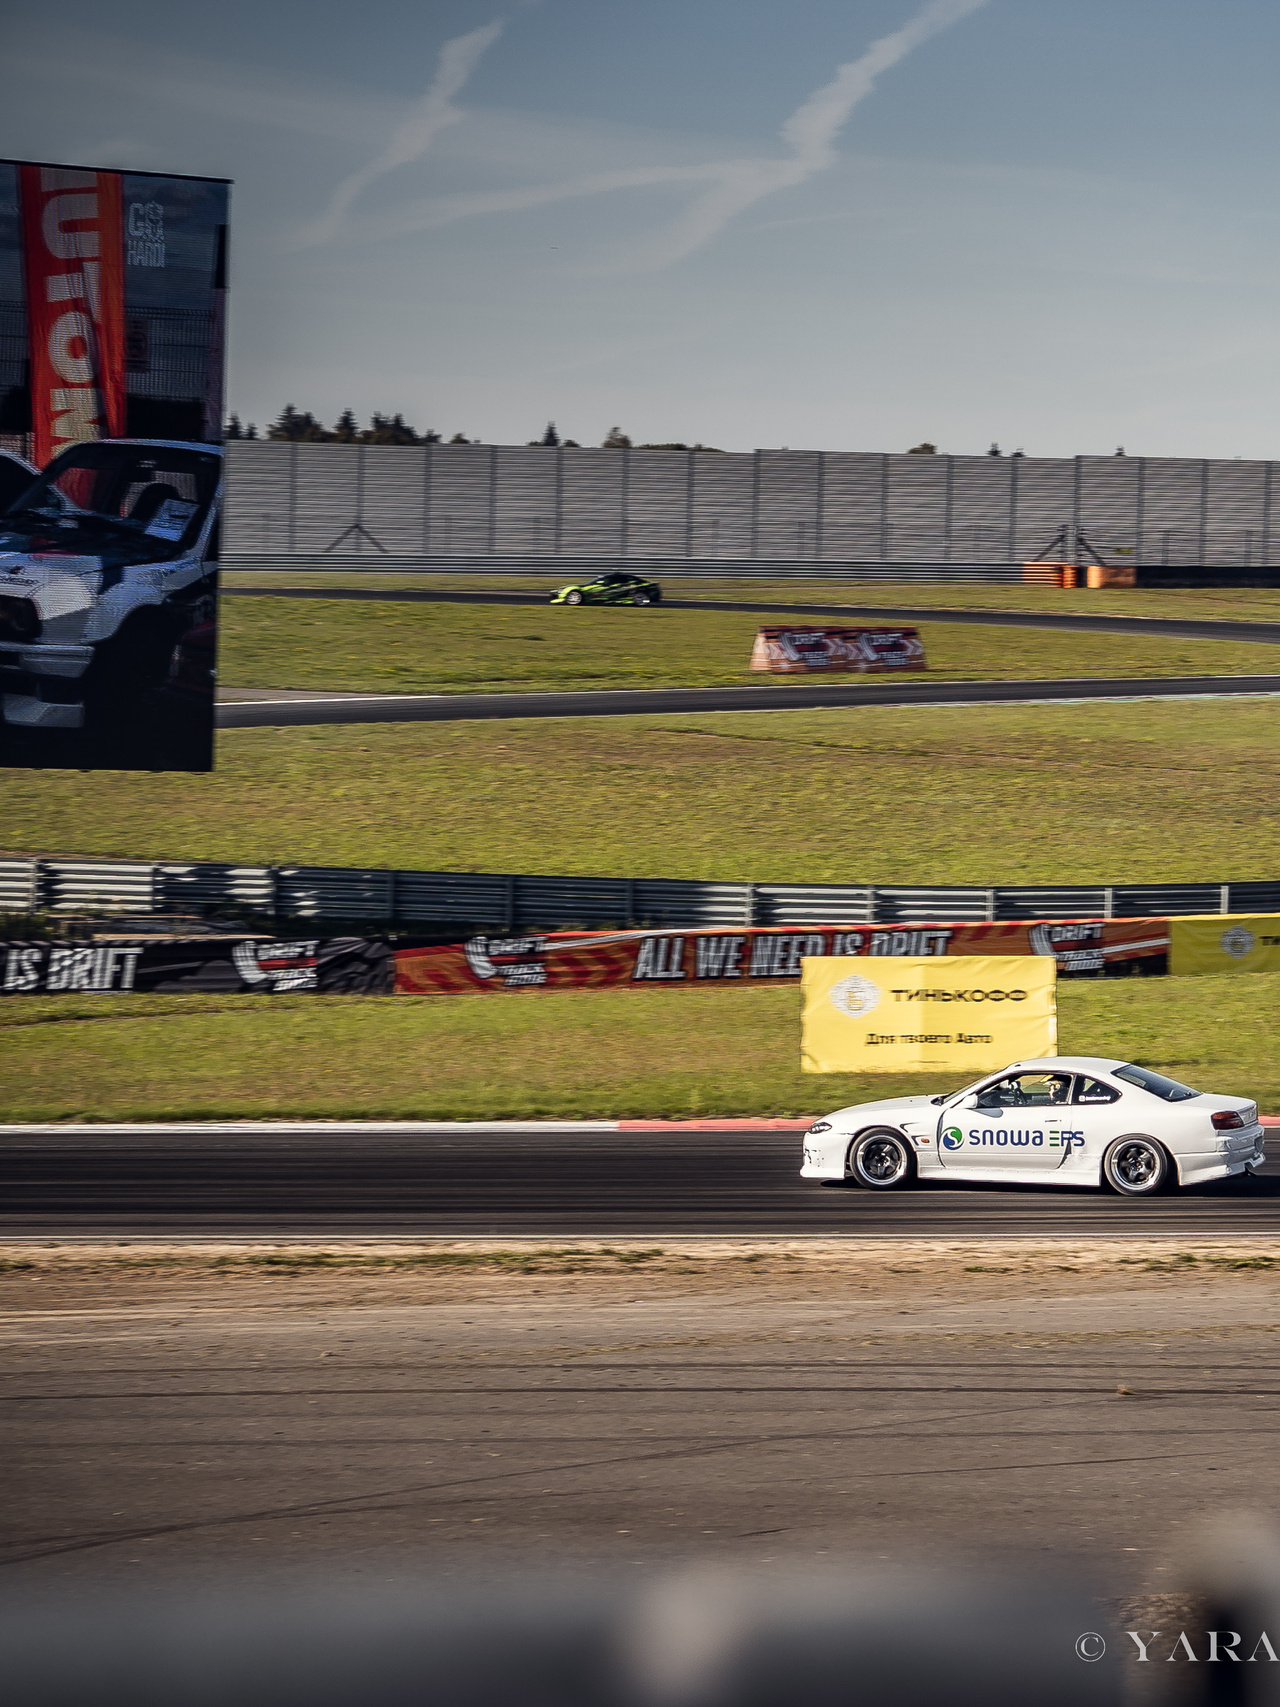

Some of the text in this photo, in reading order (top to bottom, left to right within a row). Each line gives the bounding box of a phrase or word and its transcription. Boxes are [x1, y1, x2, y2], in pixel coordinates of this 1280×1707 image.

[633, 937, 686, 979] ALL
[696, 936, 746, 978] WE
[4, 947, 144, 990] IS DRIFT
[890, 989, 1027, 1003] ТИНЬКОФФ
[864, 1033, 896, 1046] Для
[955, 1033, 993, 1044] Авто
[1049, 1130, 1086, 1147] EPS
